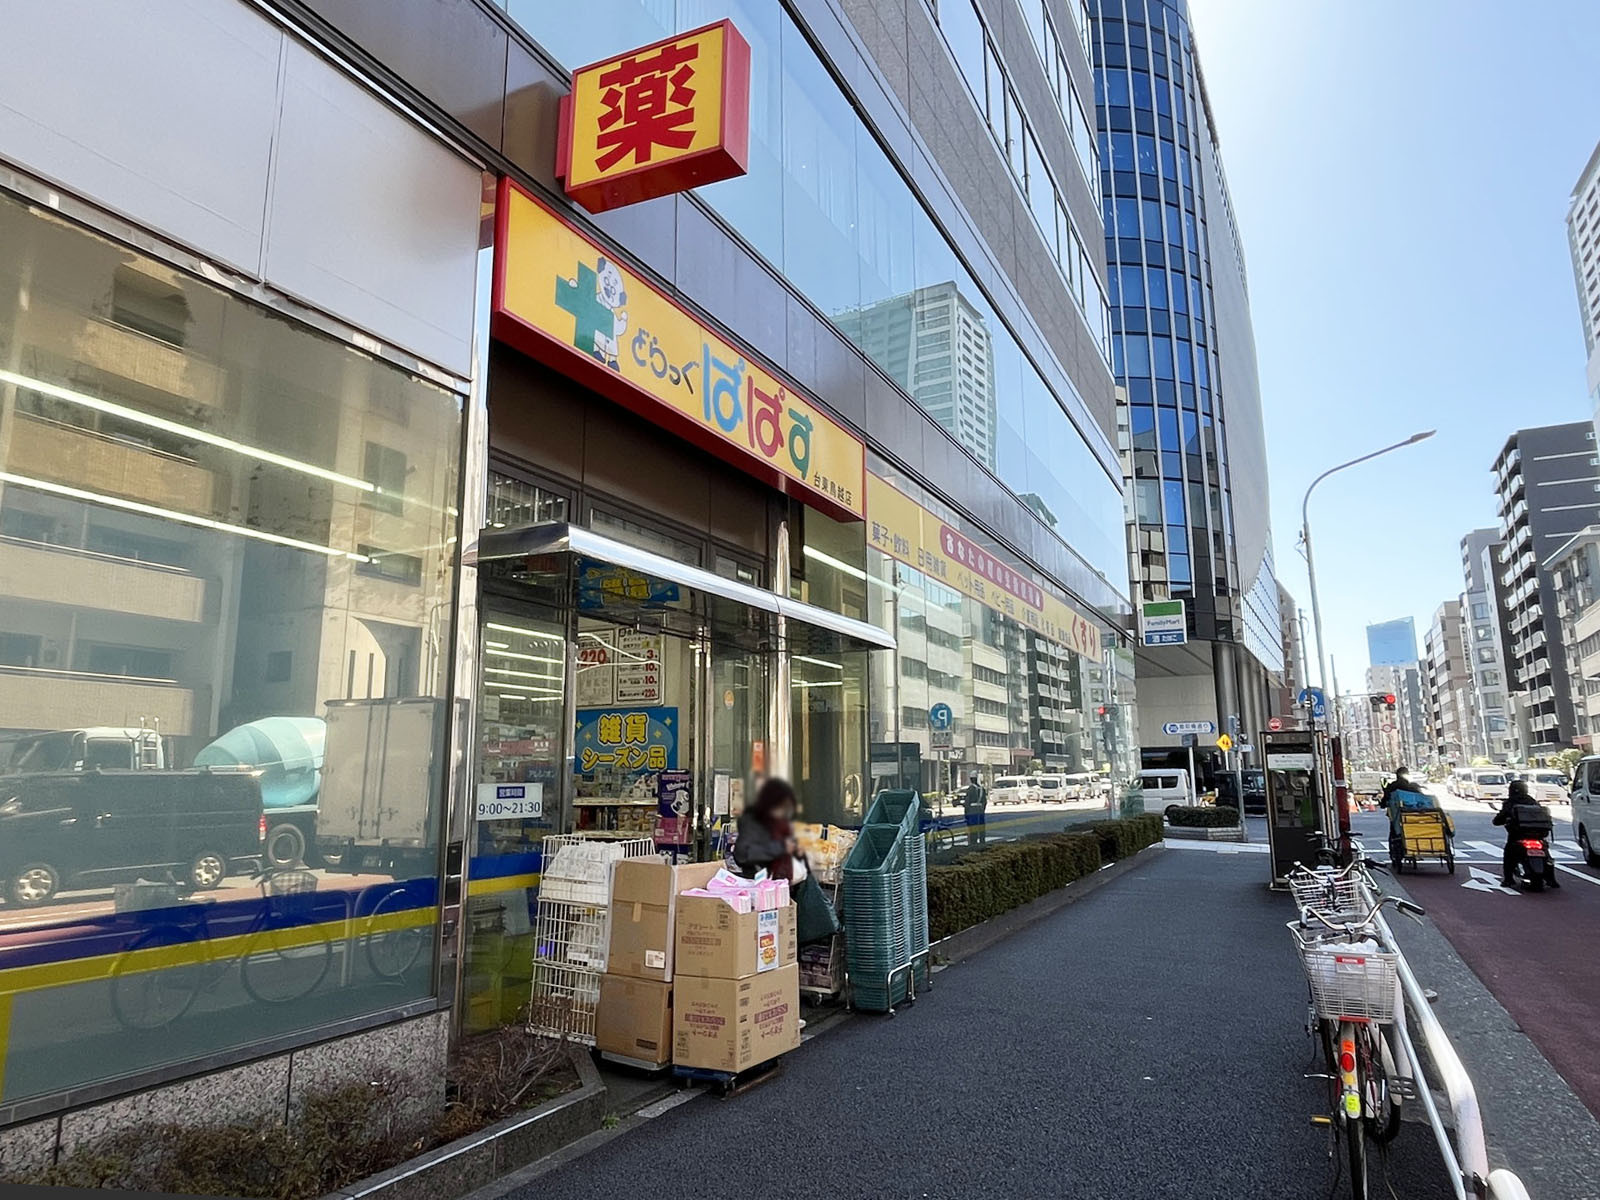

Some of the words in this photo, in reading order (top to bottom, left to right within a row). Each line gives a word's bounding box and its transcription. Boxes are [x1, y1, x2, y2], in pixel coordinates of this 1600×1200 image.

[595, 42, 699, 173] 薬
[1072, 614, 1096, 657] くすり
[1147, 618, 1180, 627] FamilyMart
[598, 713, 649, 744] 雑貨
[582, 748, 668, 772] シーズン品
